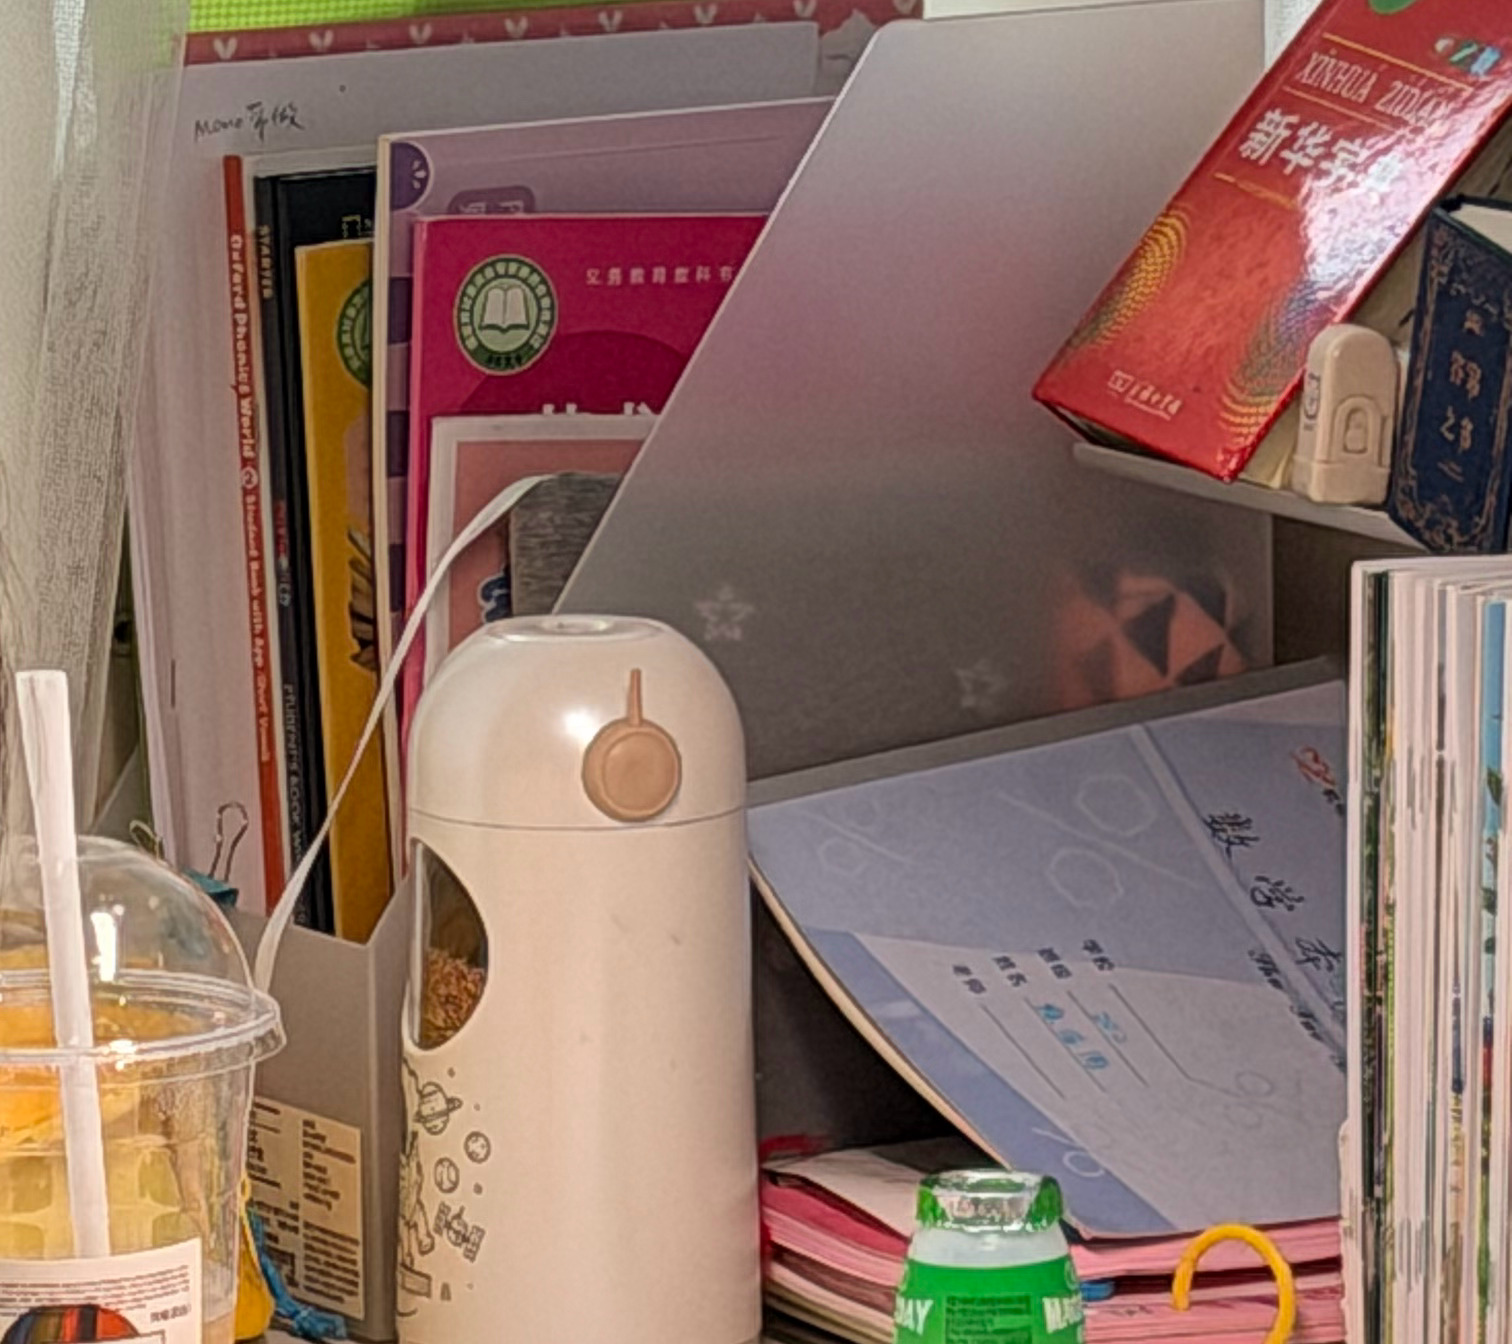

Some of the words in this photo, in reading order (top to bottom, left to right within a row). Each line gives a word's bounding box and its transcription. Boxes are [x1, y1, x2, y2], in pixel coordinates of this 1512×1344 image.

[1238, 106, 1404, 194] 新华字典
[230, 234, 248, 310] Oxford
[234, 313, 253, 395] Phonics
[239, 397, 257, 459] World
